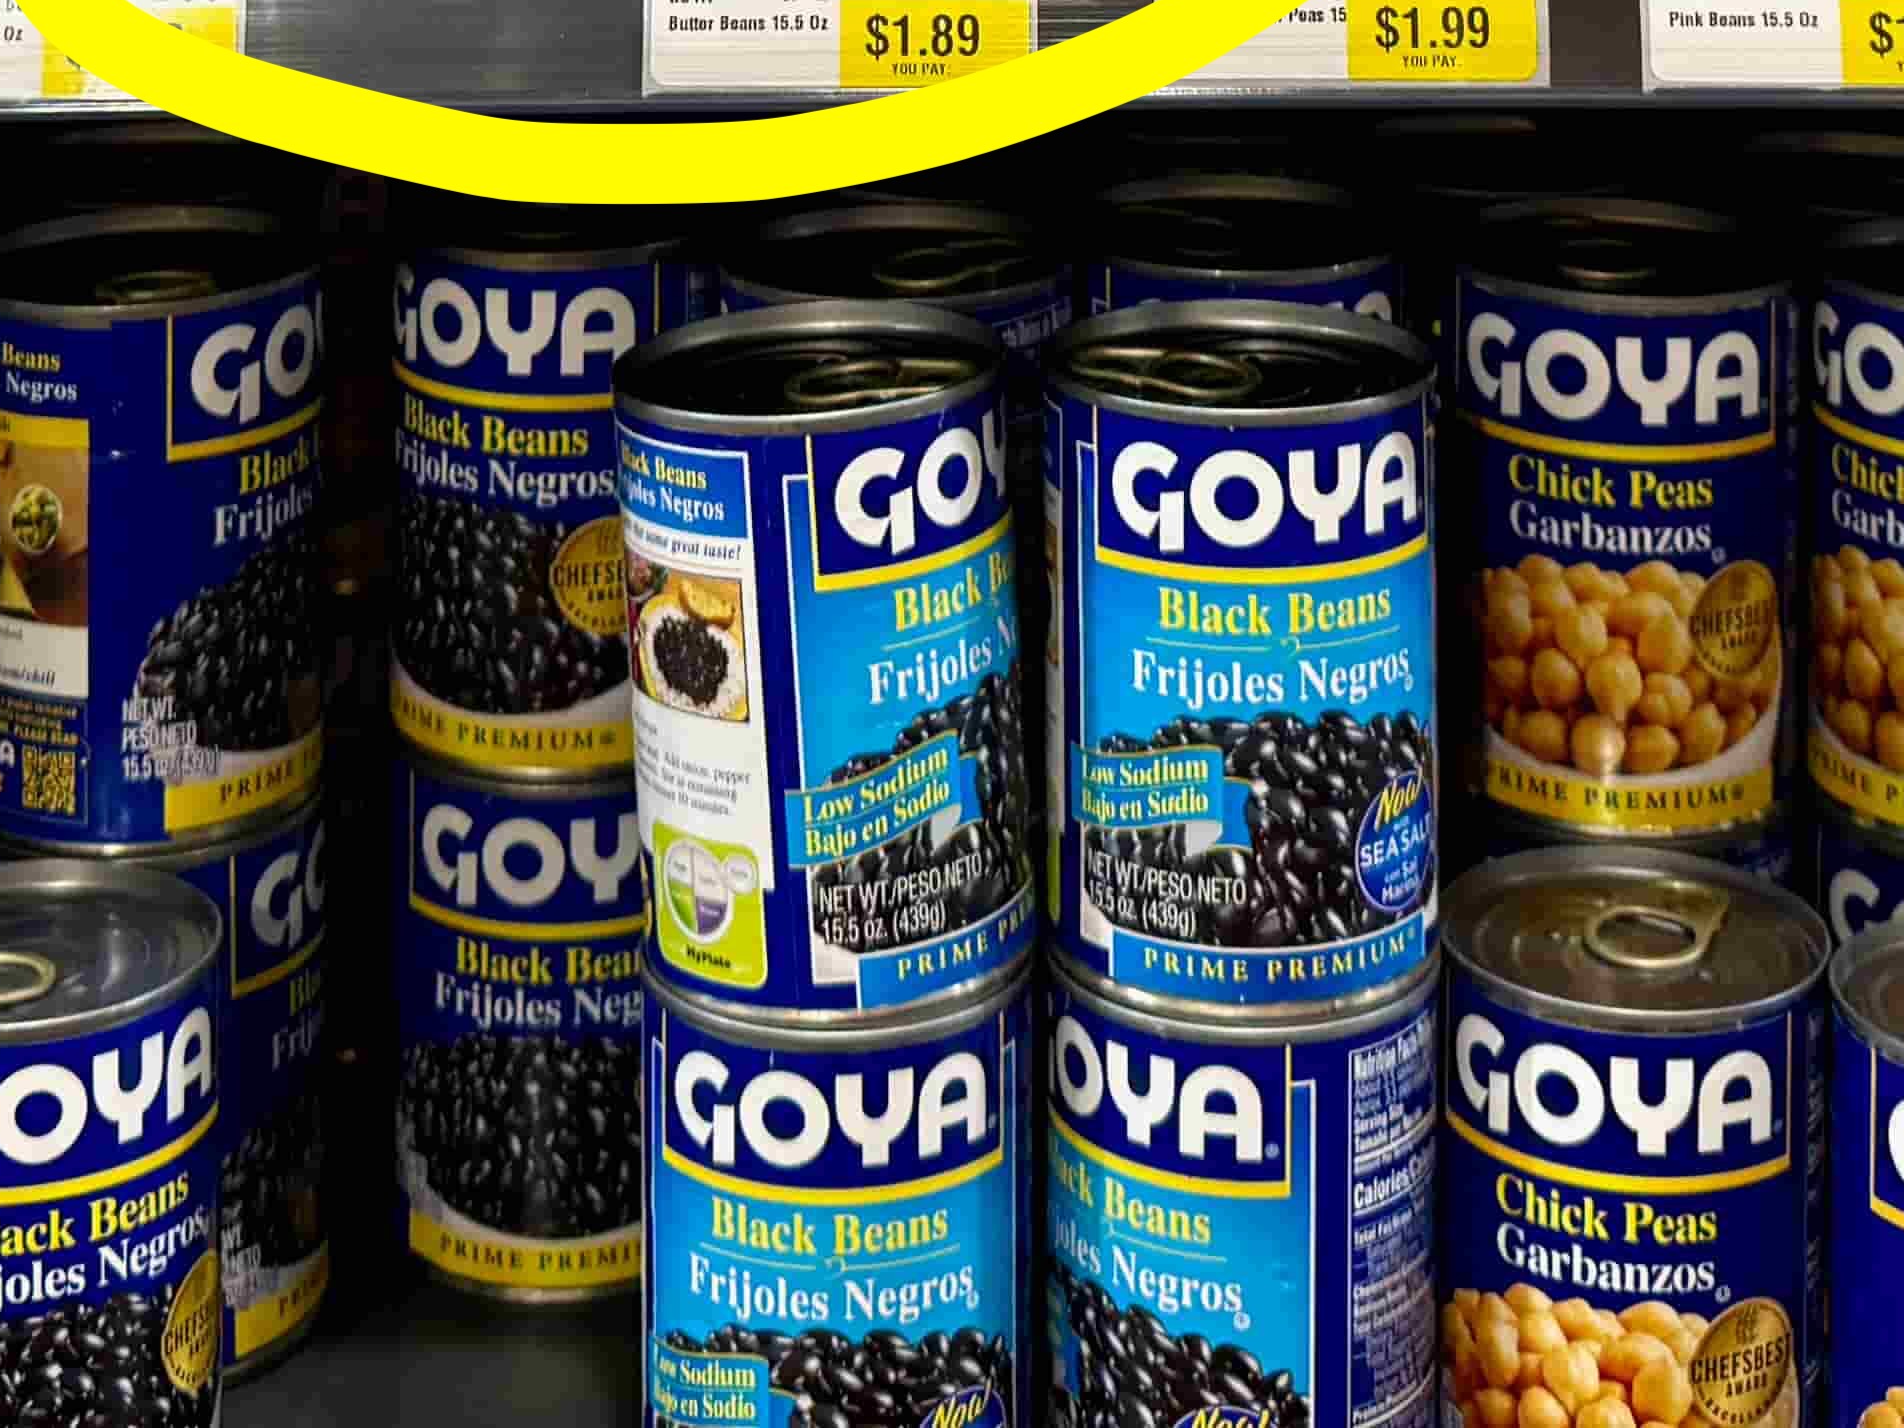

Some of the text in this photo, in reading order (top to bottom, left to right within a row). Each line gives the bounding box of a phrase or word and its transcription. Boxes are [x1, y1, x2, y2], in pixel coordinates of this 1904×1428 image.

[668, 15, 714, 32] Butter
[719, 15, 766, 31] Beans
[772, 15, 804, 31] 15.5
[865, 13, 981, 60] $1.89
[1376, 6, 1491, 51] $1.99
[1112, 432, 1419, 552] GOYA
[1158, 586, 1392, 636] Black Beans
